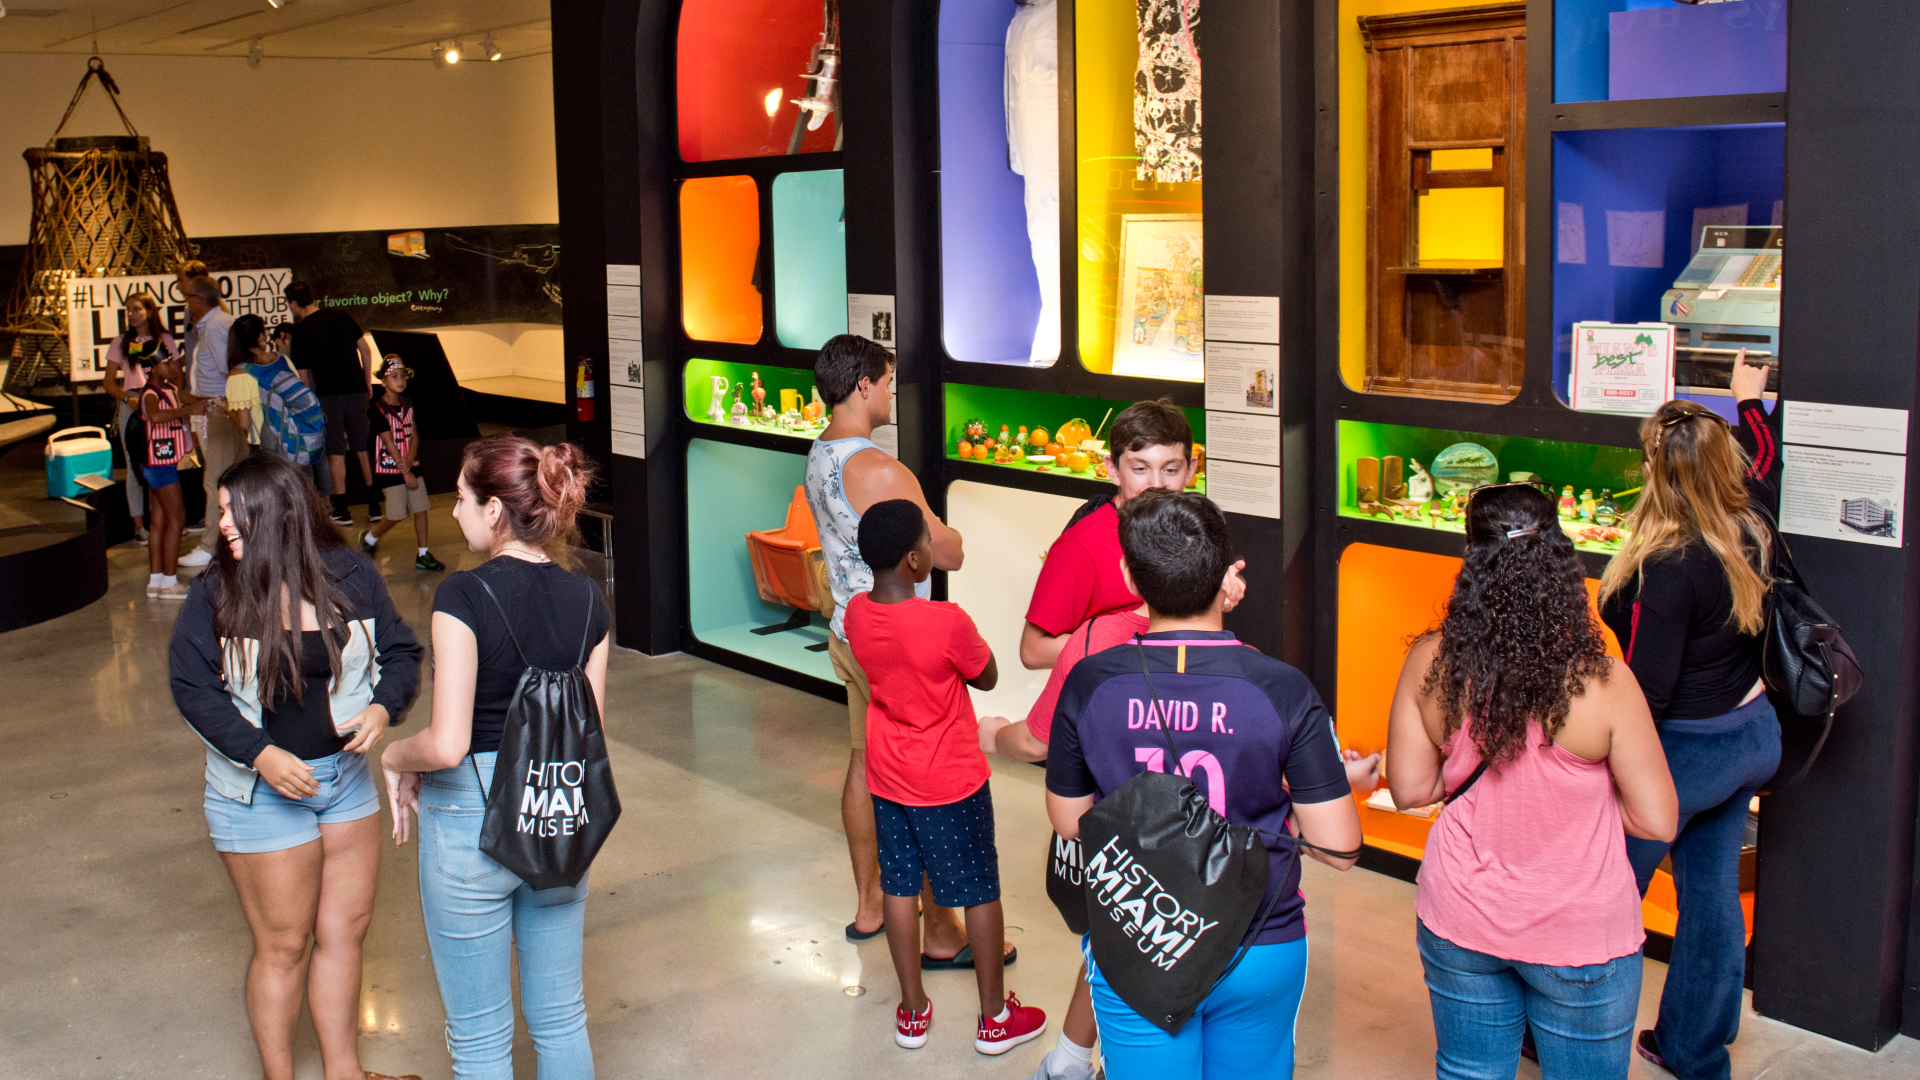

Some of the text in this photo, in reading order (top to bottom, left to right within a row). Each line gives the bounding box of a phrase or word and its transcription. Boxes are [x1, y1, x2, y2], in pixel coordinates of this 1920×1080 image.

[237, 272, 286, 297] DAY
[226, 296, 288, 315] THTUB
[324, 295, 368, 308] favorite
[371, 291, 412, 306] object?
[418, 289, 449, 304] Why?
[91, 305, 185, 345] LIE
[1592, 351, 1643, 369] best
[1594, 362, 1647, 376] PIZZA
[1127, 698, 1234, 735] DAVID R.
[1103, 834, 1219, 939] HISTORY
[1089, 850, 1196, 959] MIAMI
[1084, 865, 1177, 972] MUSEUM
[977, 1027, 1007, 1039] UTICA
